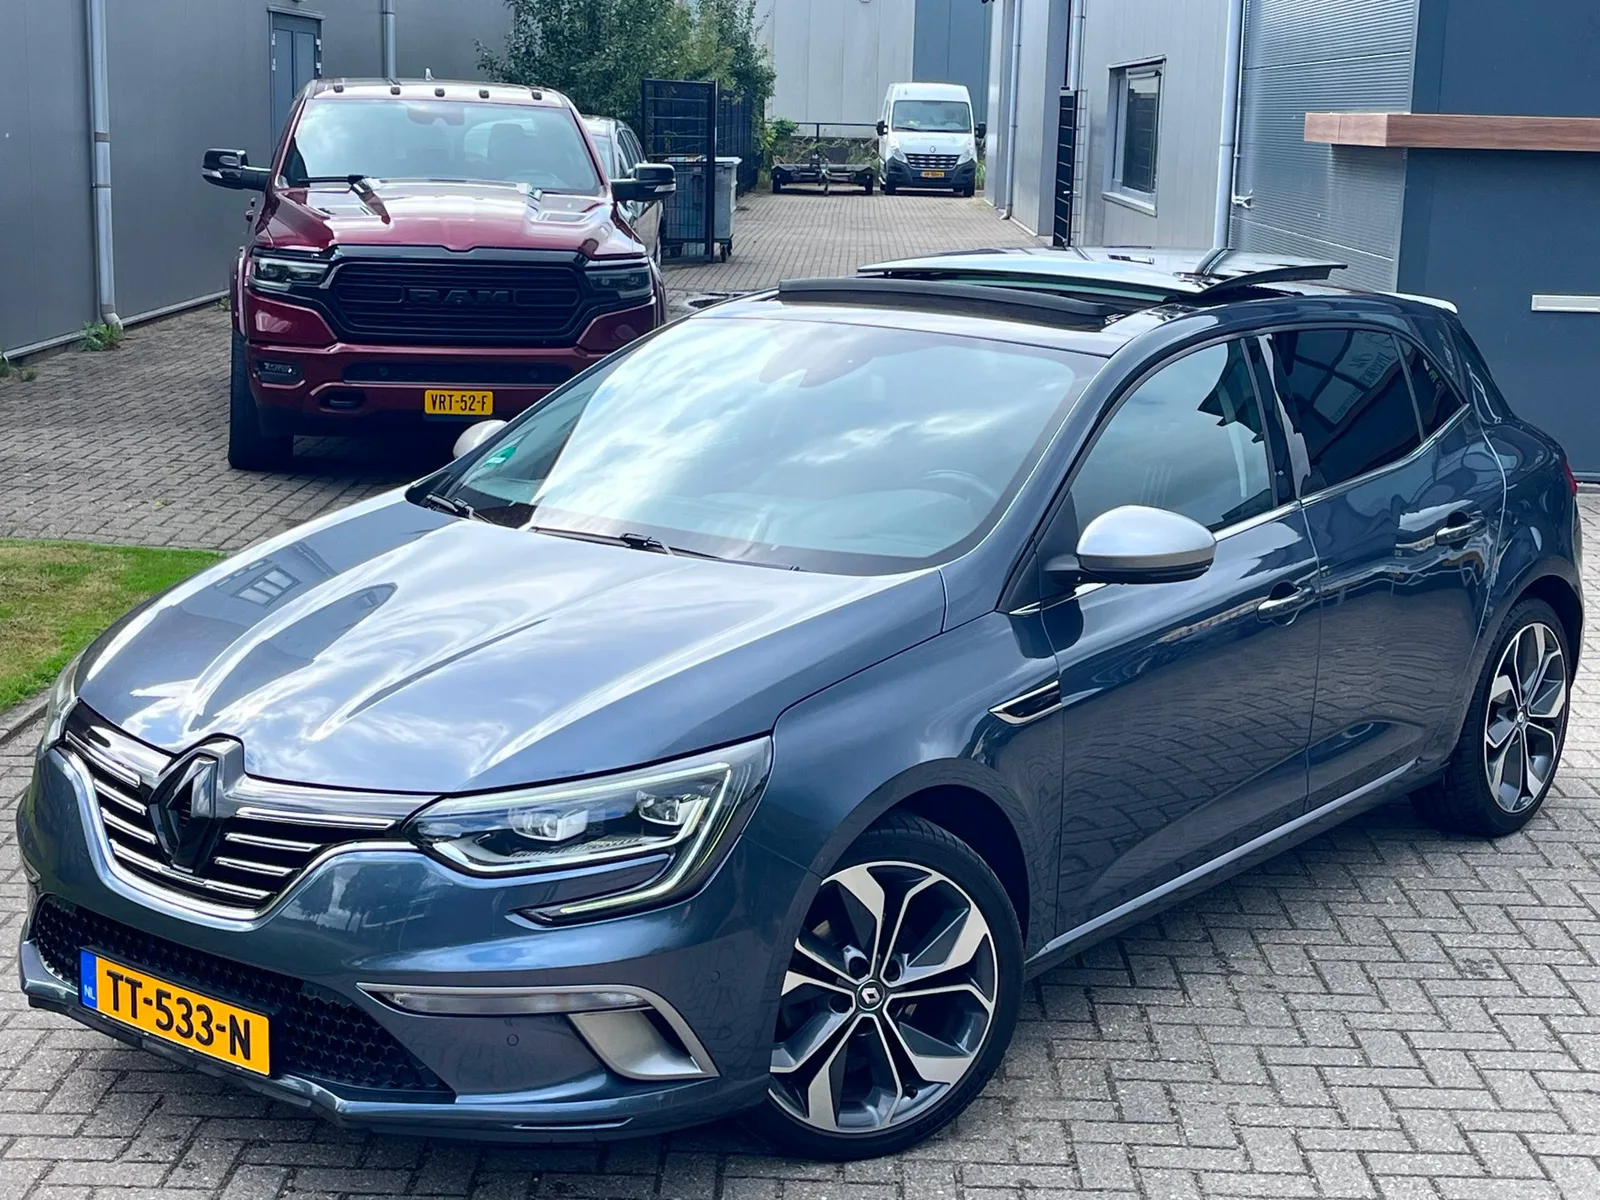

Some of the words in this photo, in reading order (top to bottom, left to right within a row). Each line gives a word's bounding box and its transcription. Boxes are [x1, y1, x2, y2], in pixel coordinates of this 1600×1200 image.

[406, 288, 511, 304] RAM
[431, 394, 488, 411] VRT-52-F
[84, 984, 96, 1000] NL
[106, 969, 251, 1061] TT-533-N
